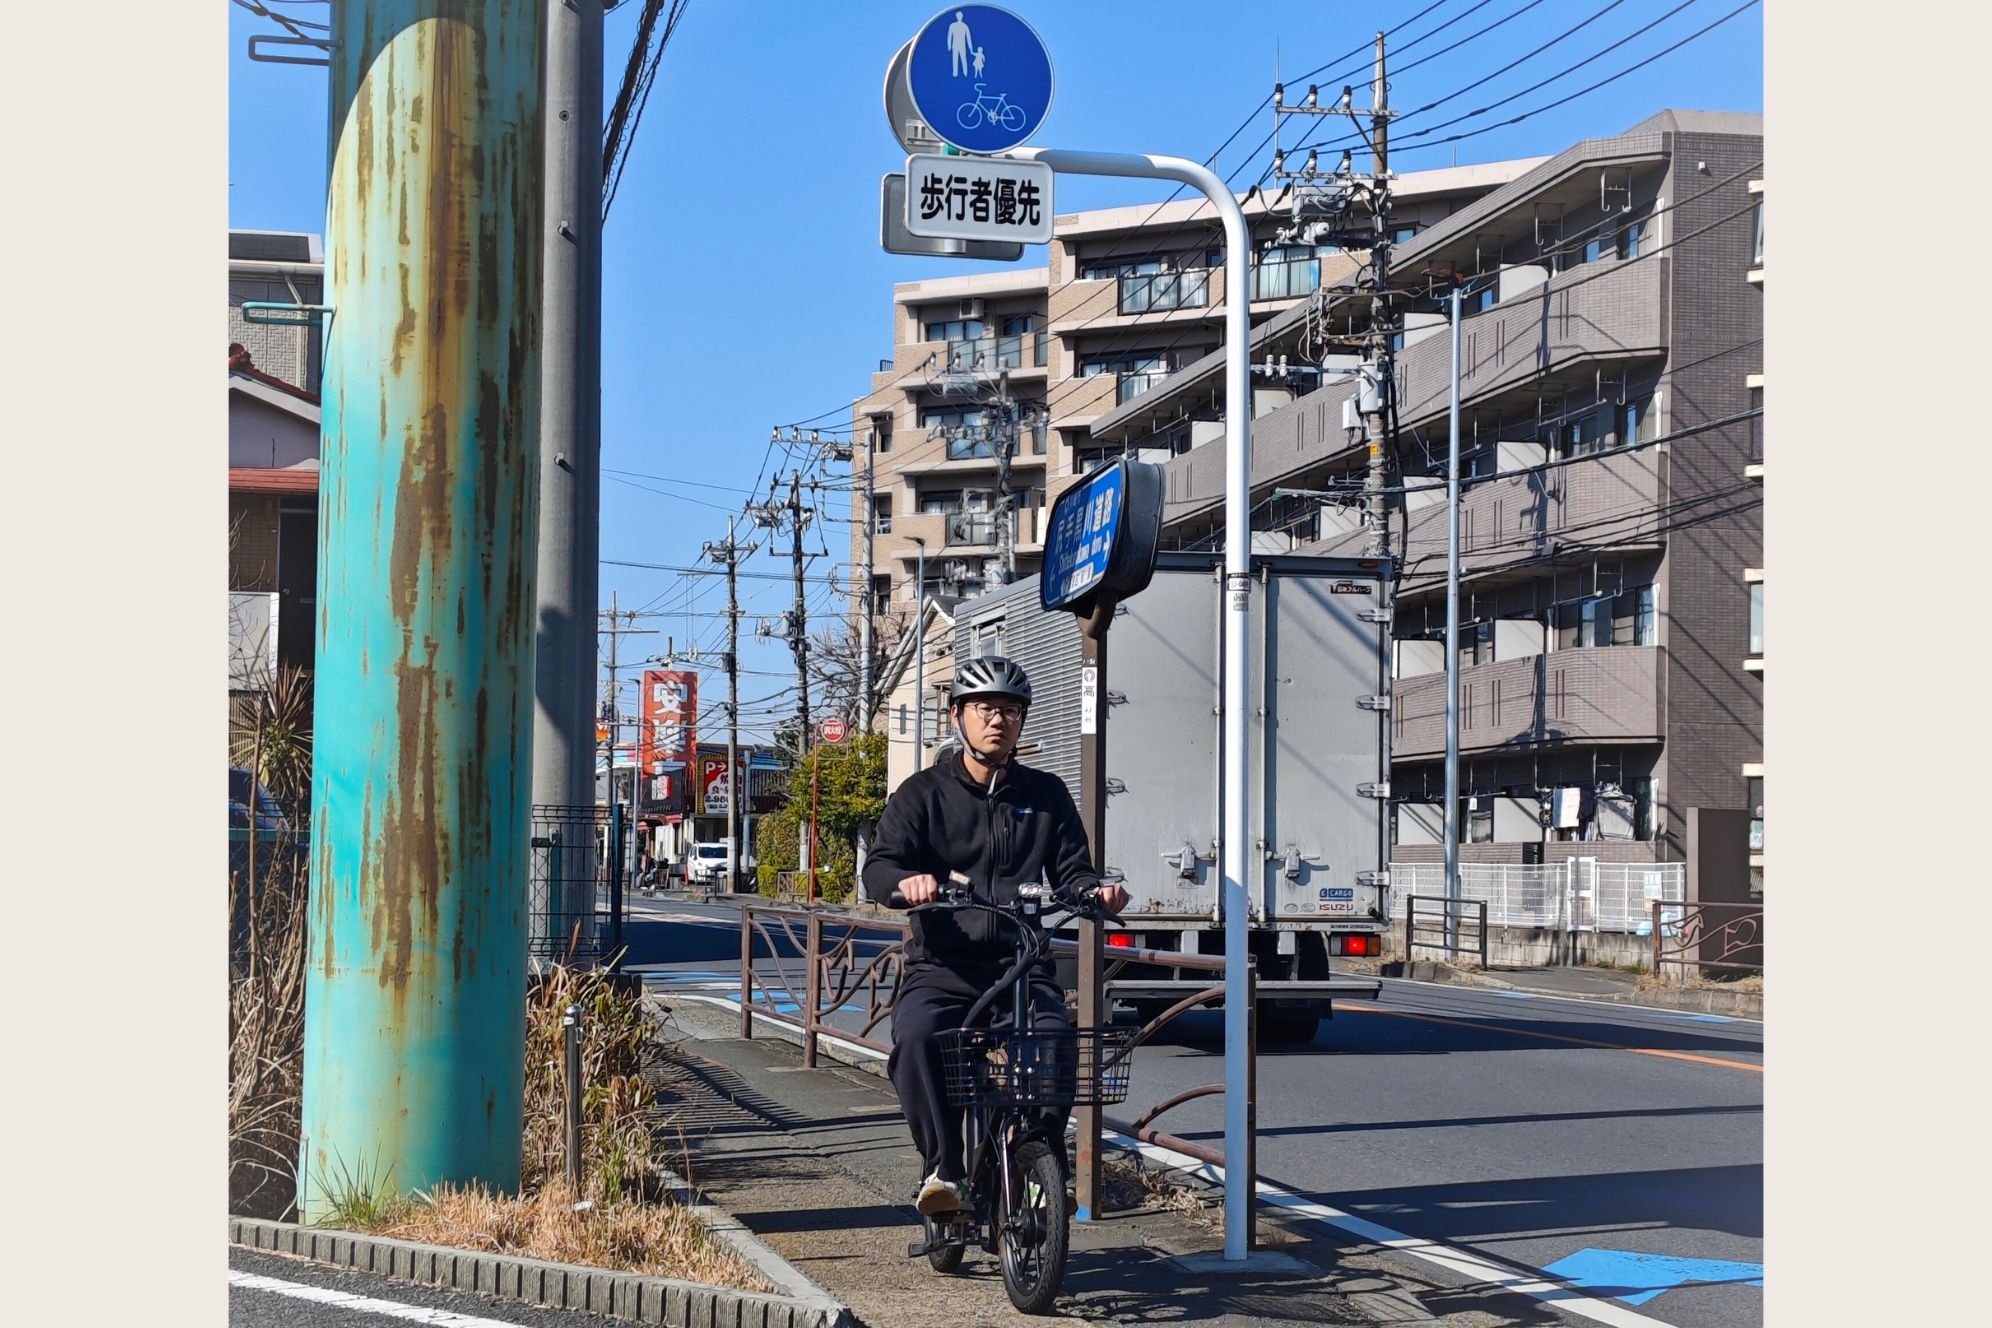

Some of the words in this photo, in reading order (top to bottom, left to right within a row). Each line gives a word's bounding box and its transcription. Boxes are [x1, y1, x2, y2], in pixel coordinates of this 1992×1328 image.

[920, 172, 1040, 226] 歩行者優先
[705, 762, 716, 774] P
[1319, 903, 1354, 911] ISUZU
